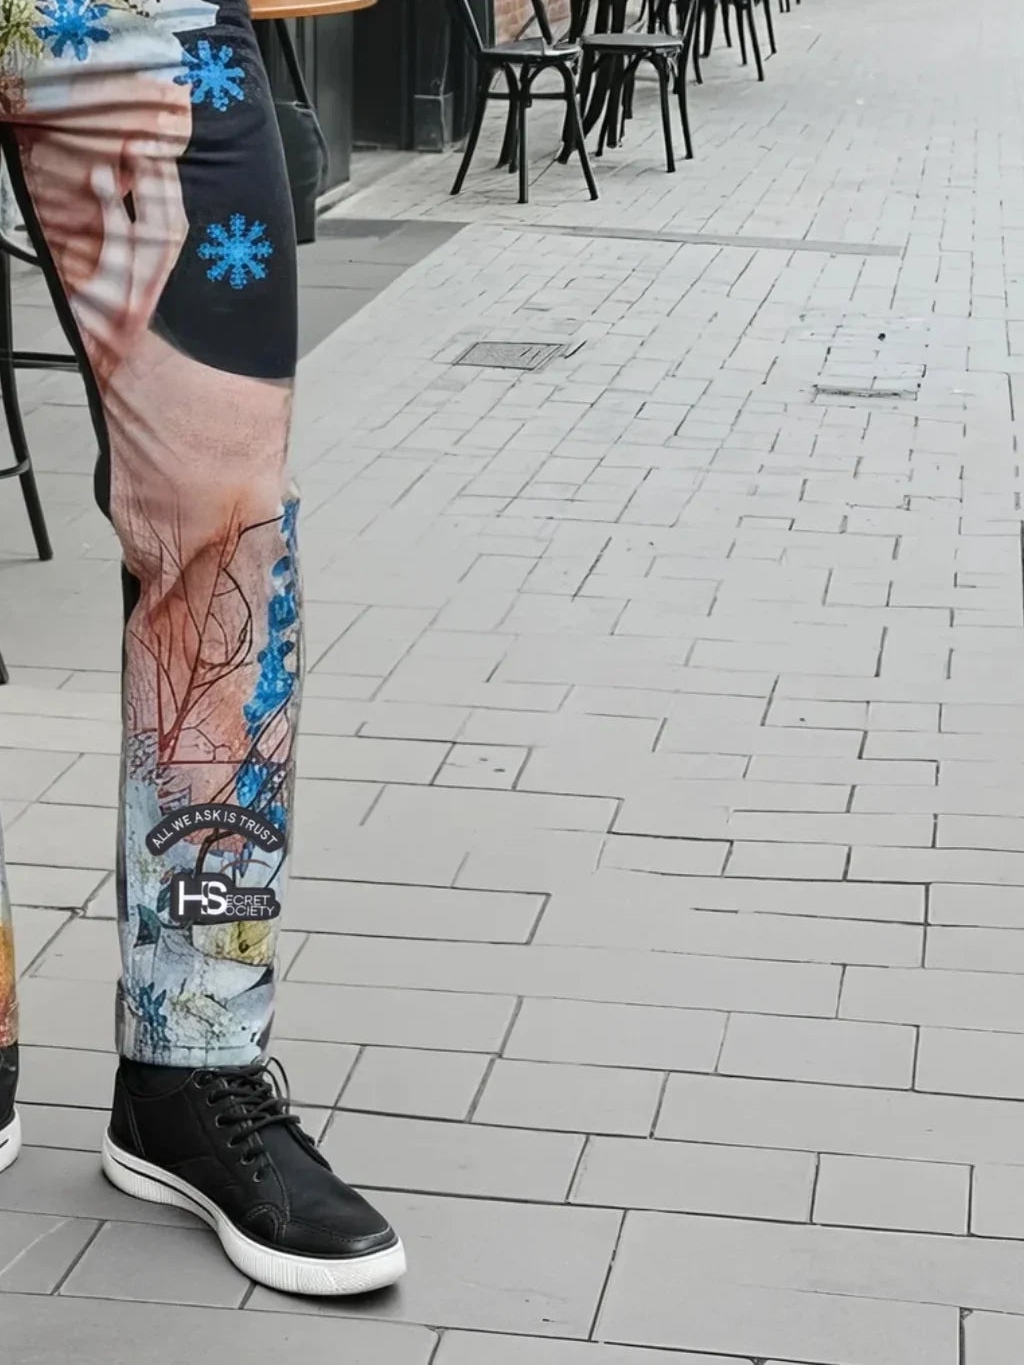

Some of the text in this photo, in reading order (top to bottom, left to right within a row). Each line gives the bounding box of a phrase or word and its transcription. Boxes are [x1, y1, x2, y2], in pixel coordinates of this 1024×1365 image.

[152, 809, 278, 849] ALL WE ASK IS TRUST
